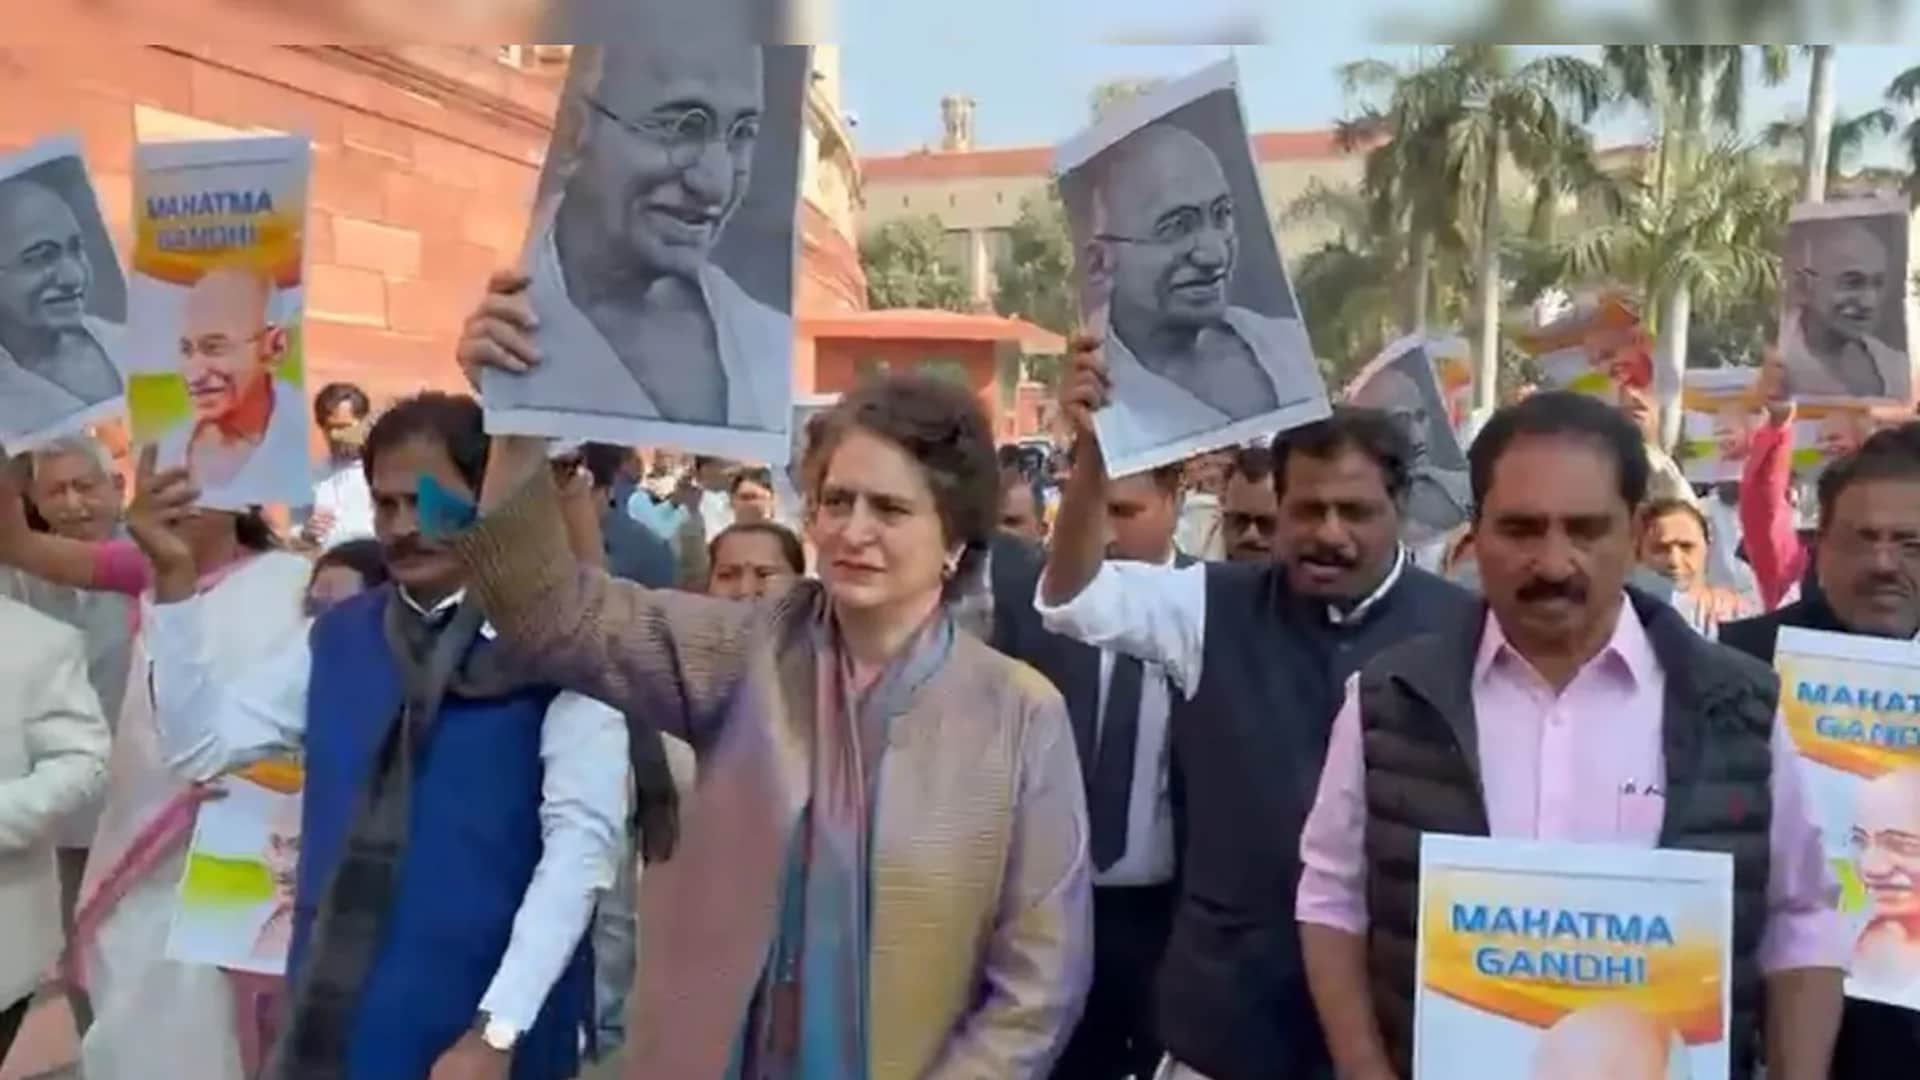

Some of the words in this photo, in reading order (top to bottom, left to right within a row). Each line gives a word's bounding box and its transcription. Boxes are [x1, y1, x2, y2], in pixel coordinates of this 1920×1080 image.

[146, 188, 272, 219] MAHATMA
[1451, 904, 1674, 944] MAHATMA
[1476, 947, 1645, 983] GANDHI
